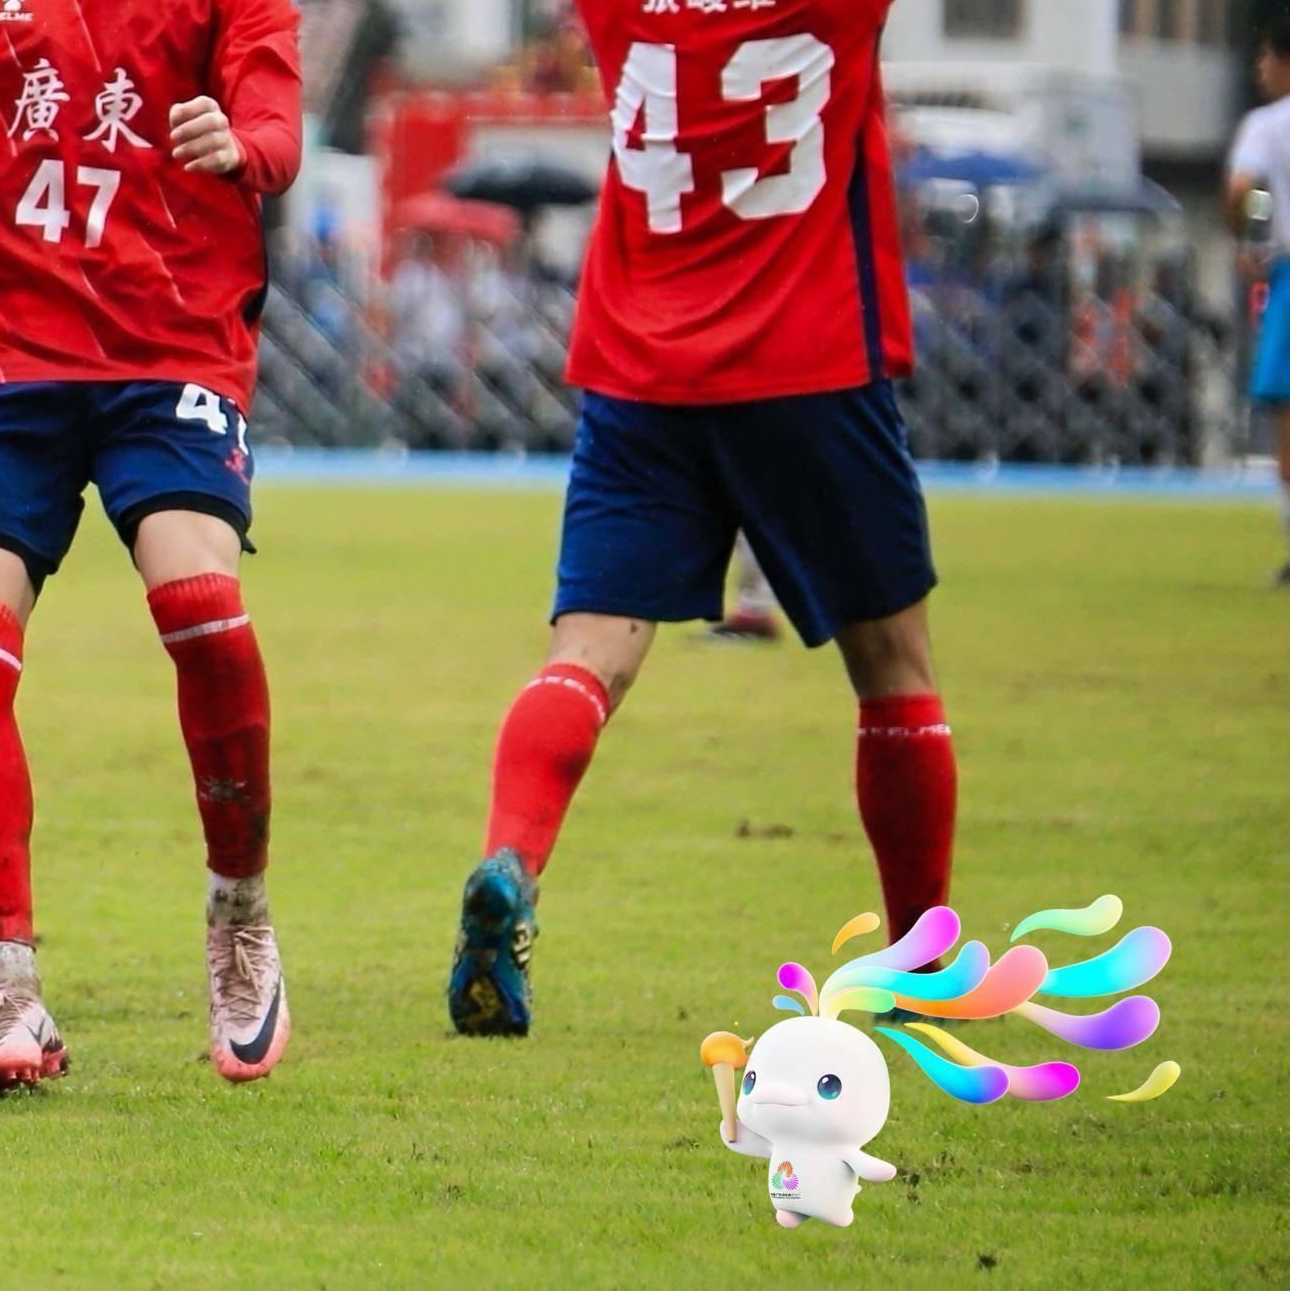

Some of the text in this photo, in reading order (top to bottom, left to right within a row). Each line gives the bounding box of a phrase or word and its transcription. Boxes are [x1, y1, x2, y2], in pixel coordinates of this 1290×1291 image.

[7, 57, 153, 153] 廣東
[611, 32, 836, 235] 43
[16, 160, 122, 249] 47
